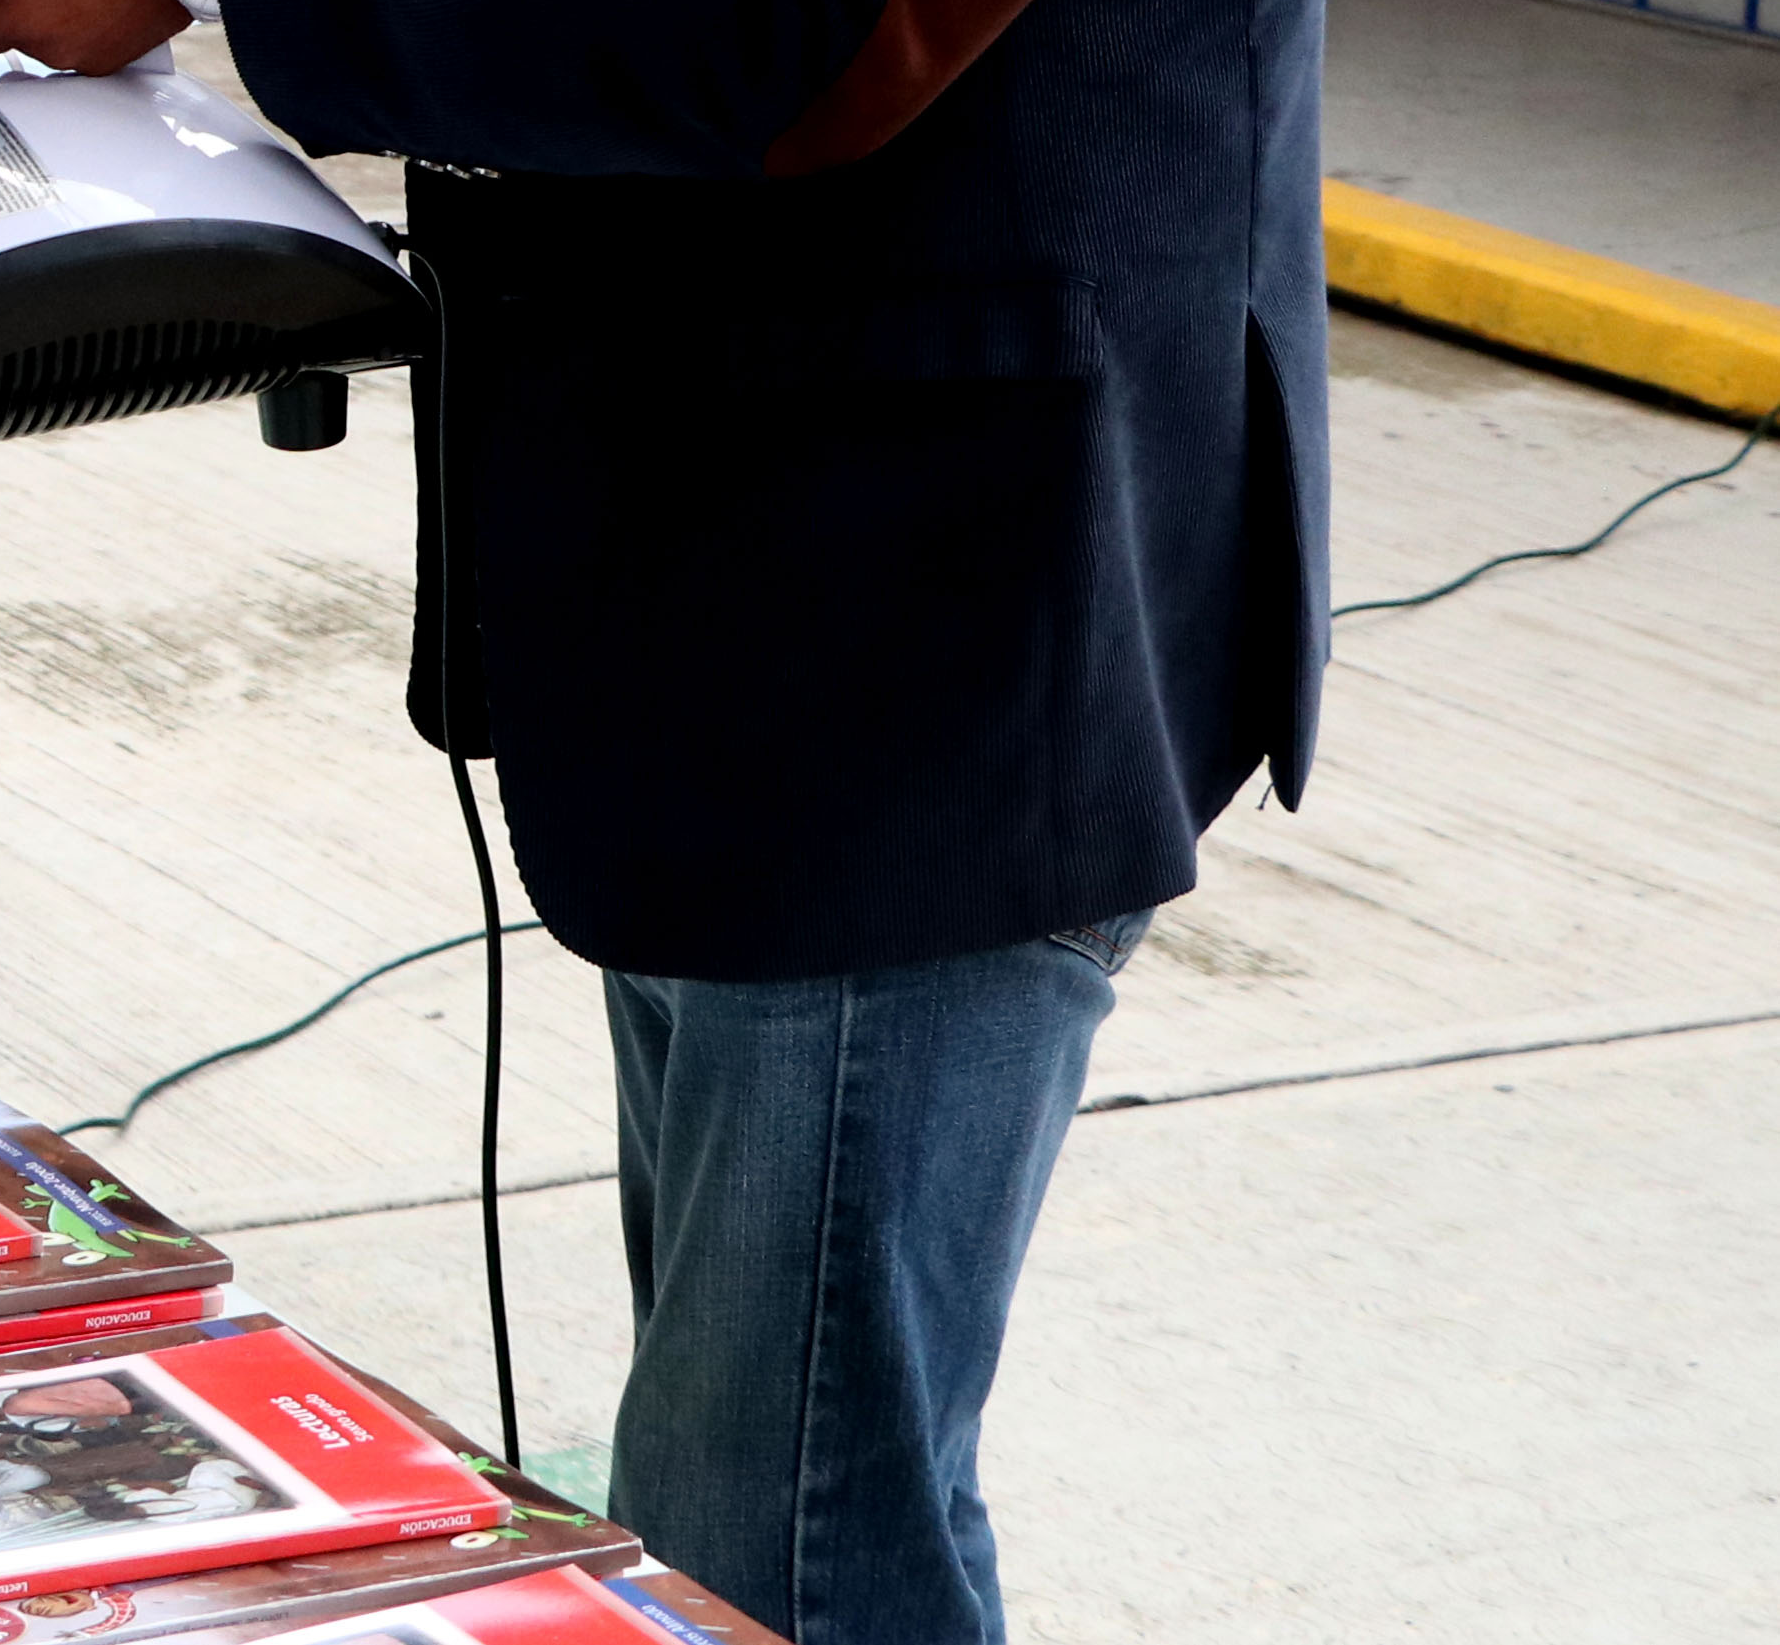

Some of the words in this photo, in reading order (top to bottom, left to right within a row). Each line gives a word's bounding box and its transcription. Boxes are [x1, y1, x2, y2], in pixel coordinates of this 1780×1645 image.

[85, 1310, 151, 1328] EDUCACIÓN
[305, 1393, 347, 1418] grado
[270, 1396, 351, 1450] Lecturas
[336, 1416, 375, 1443] Sexto
[399, 1513, 472, 1535] EDUCACIÓN
